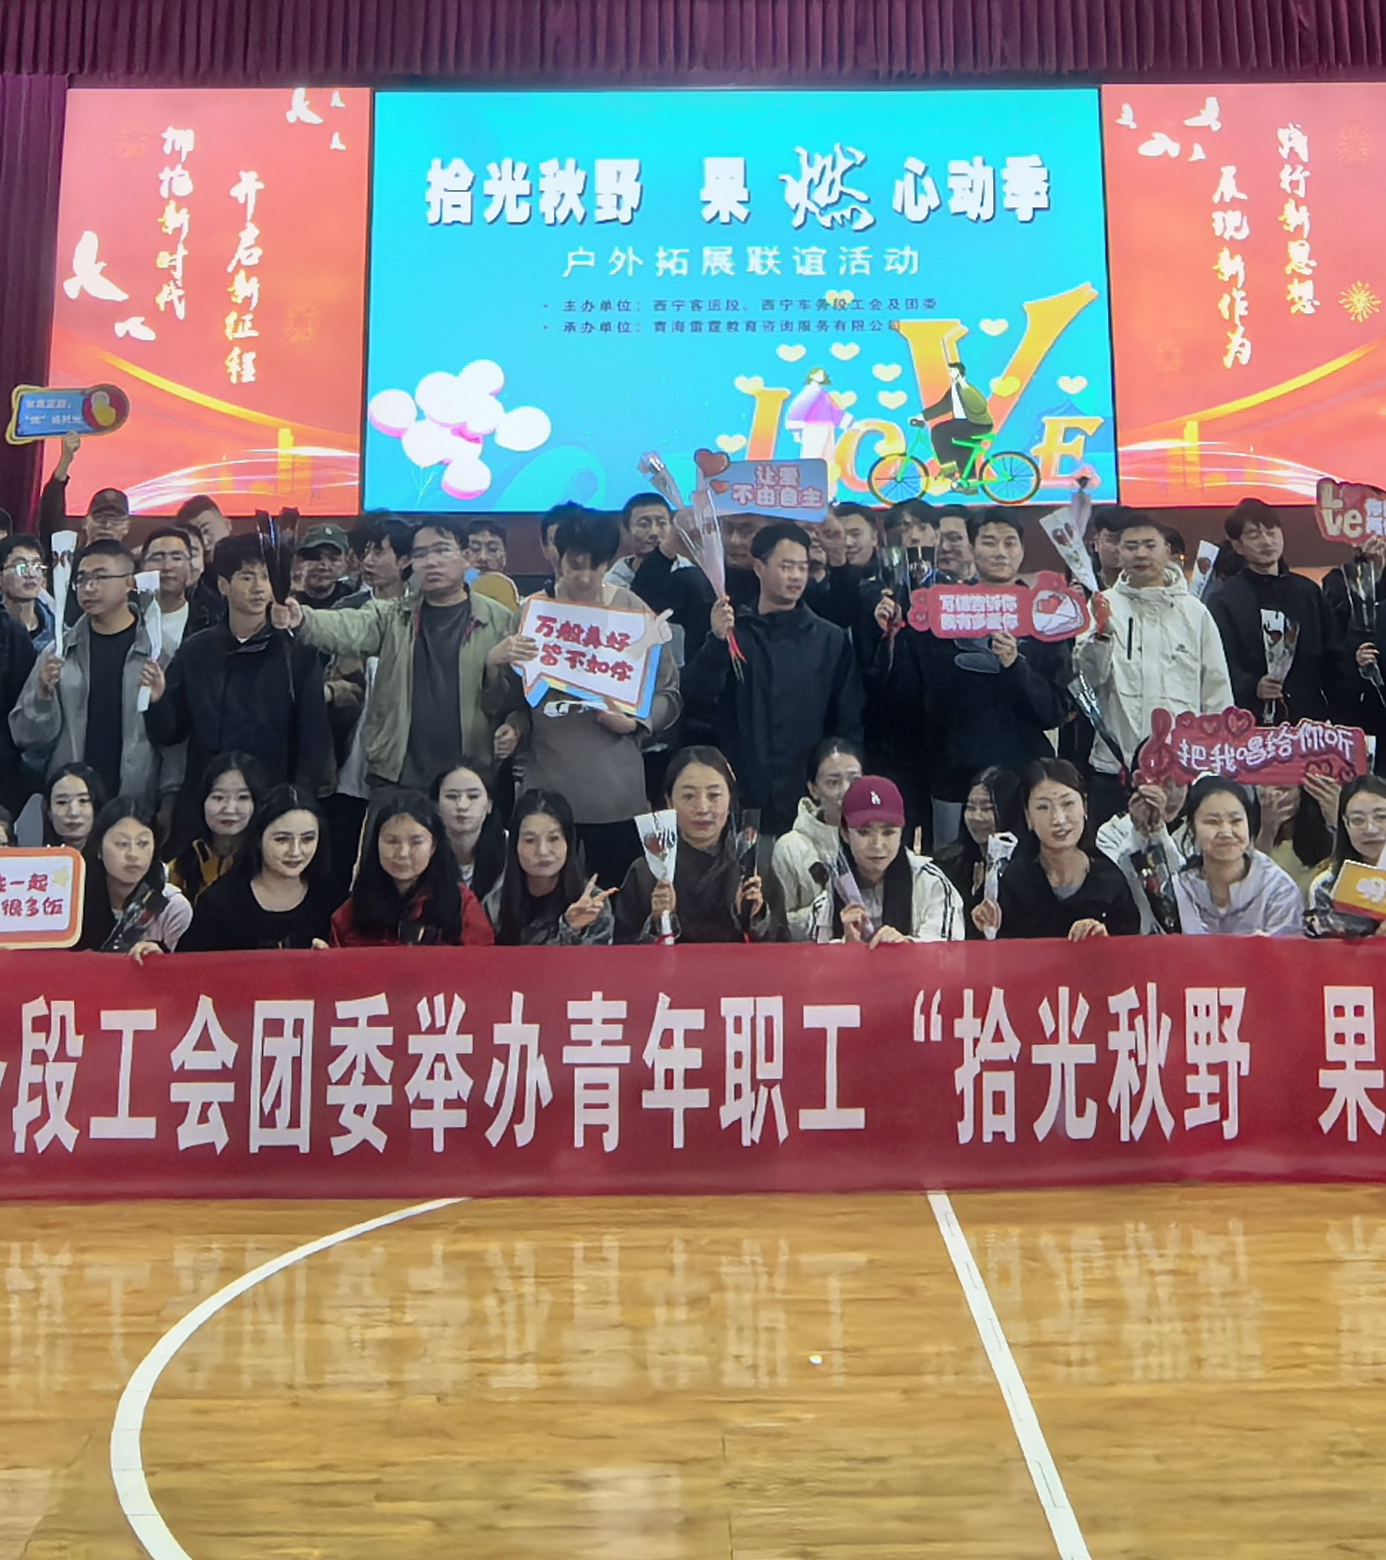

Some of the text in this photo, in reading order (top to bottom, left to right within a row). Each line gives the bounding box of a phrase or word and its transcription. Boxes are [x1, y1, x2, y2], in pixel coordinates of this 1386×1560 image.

[155, 125, 196, 321] 拥抱新时代
[224, 170, 265, 385] 开启新征程
[424, 155, 643, 226] 拾光秋野
[561, 244, 920, 279] 户外拓展联谊活动
[1211, 165, 1251, 370] 展现新作为
[1276, 122, 1321, 316] 践行新思想
[1176, 720, 1355, 774] 把我唱给你听
